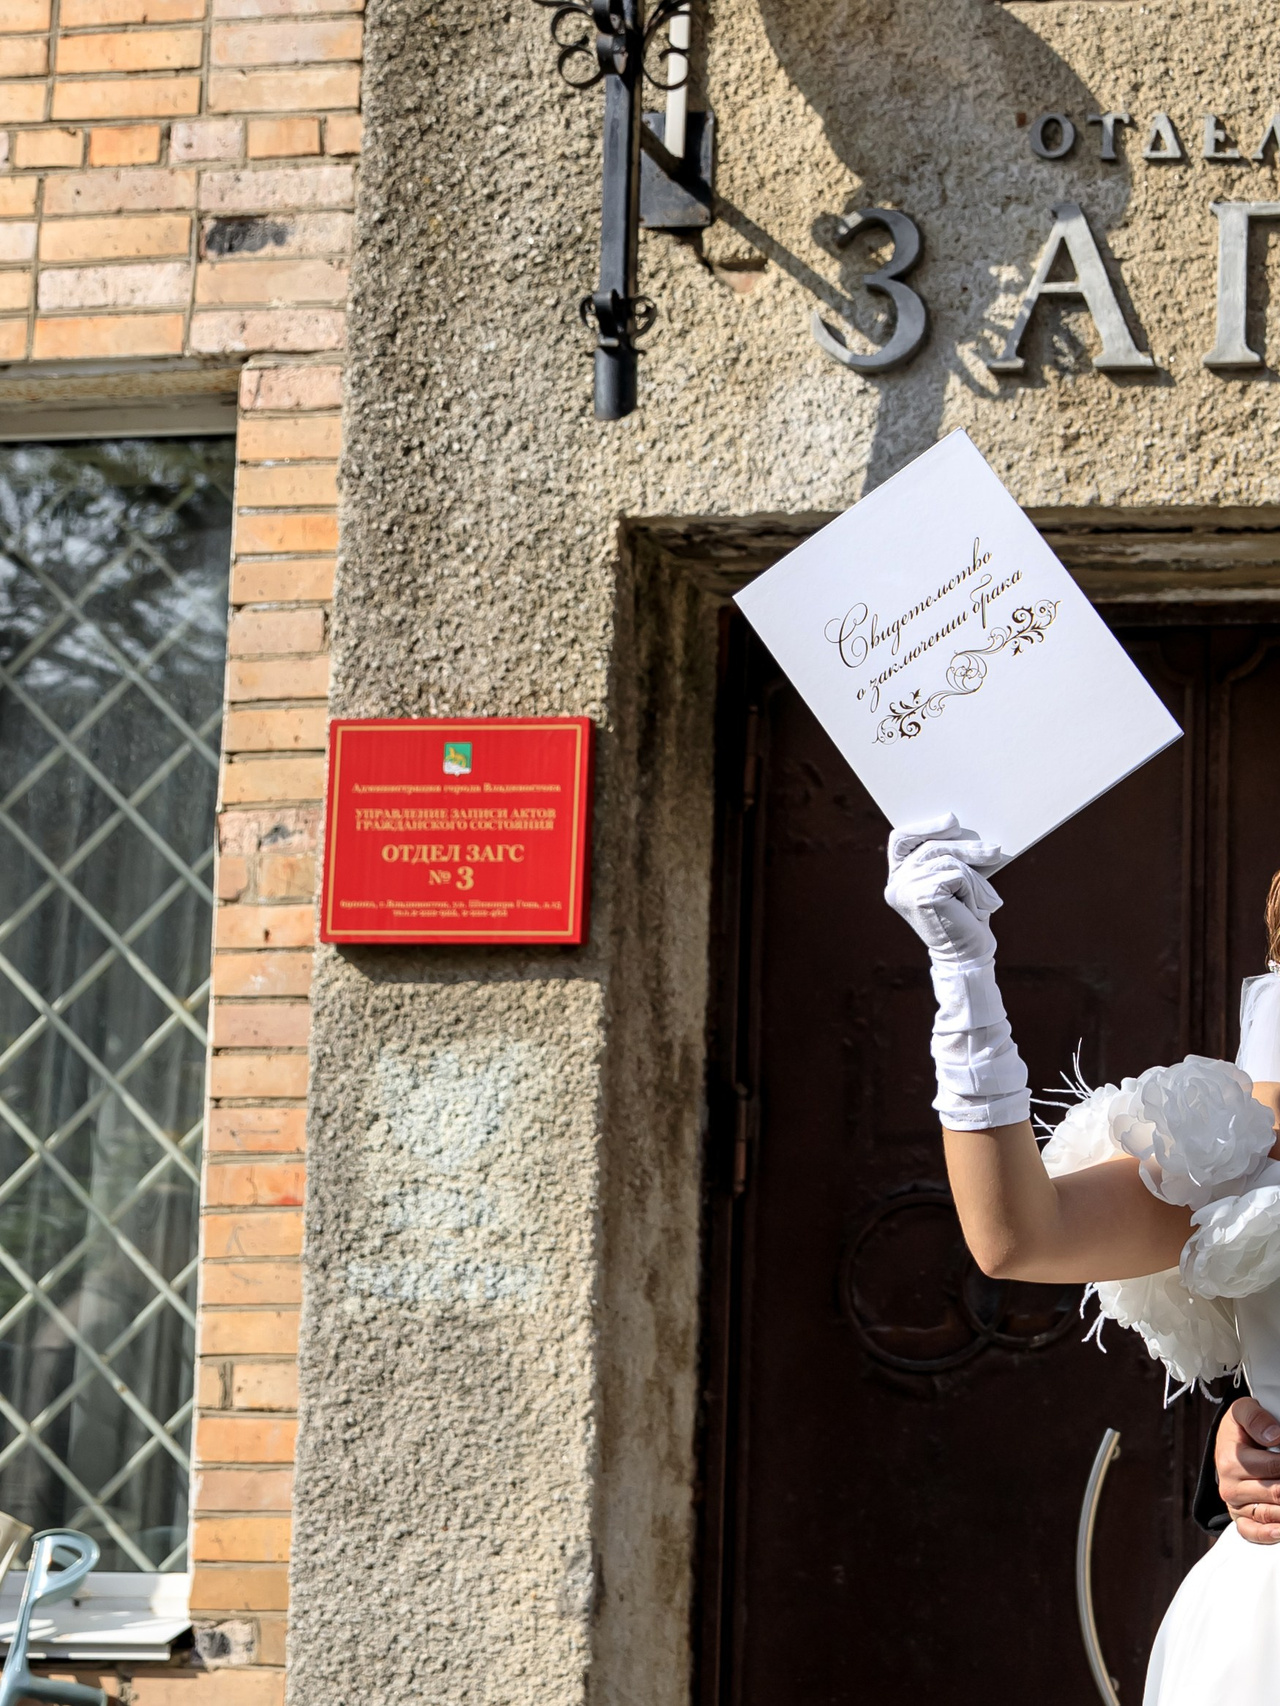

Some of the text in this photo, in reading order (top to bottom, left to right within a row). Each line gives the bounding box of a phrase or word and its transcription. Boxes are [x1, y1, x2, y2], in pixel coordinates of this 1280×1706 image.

[824, 537, 992, 668] Свидетельство
[856, 573, 1023, 714] о заключении брака
[355, 808, 557, 819] УПРАВЛЕНИЕ ЗАПИСИ АКТОВ
[355, 819, 554, 832] ГРАЖДАНСКОГО СОСТОЯНИЯ
[381, 844, 525, 865] ОТДЕЛ ЗАГС
[429, 866, 474, 891] № 3
